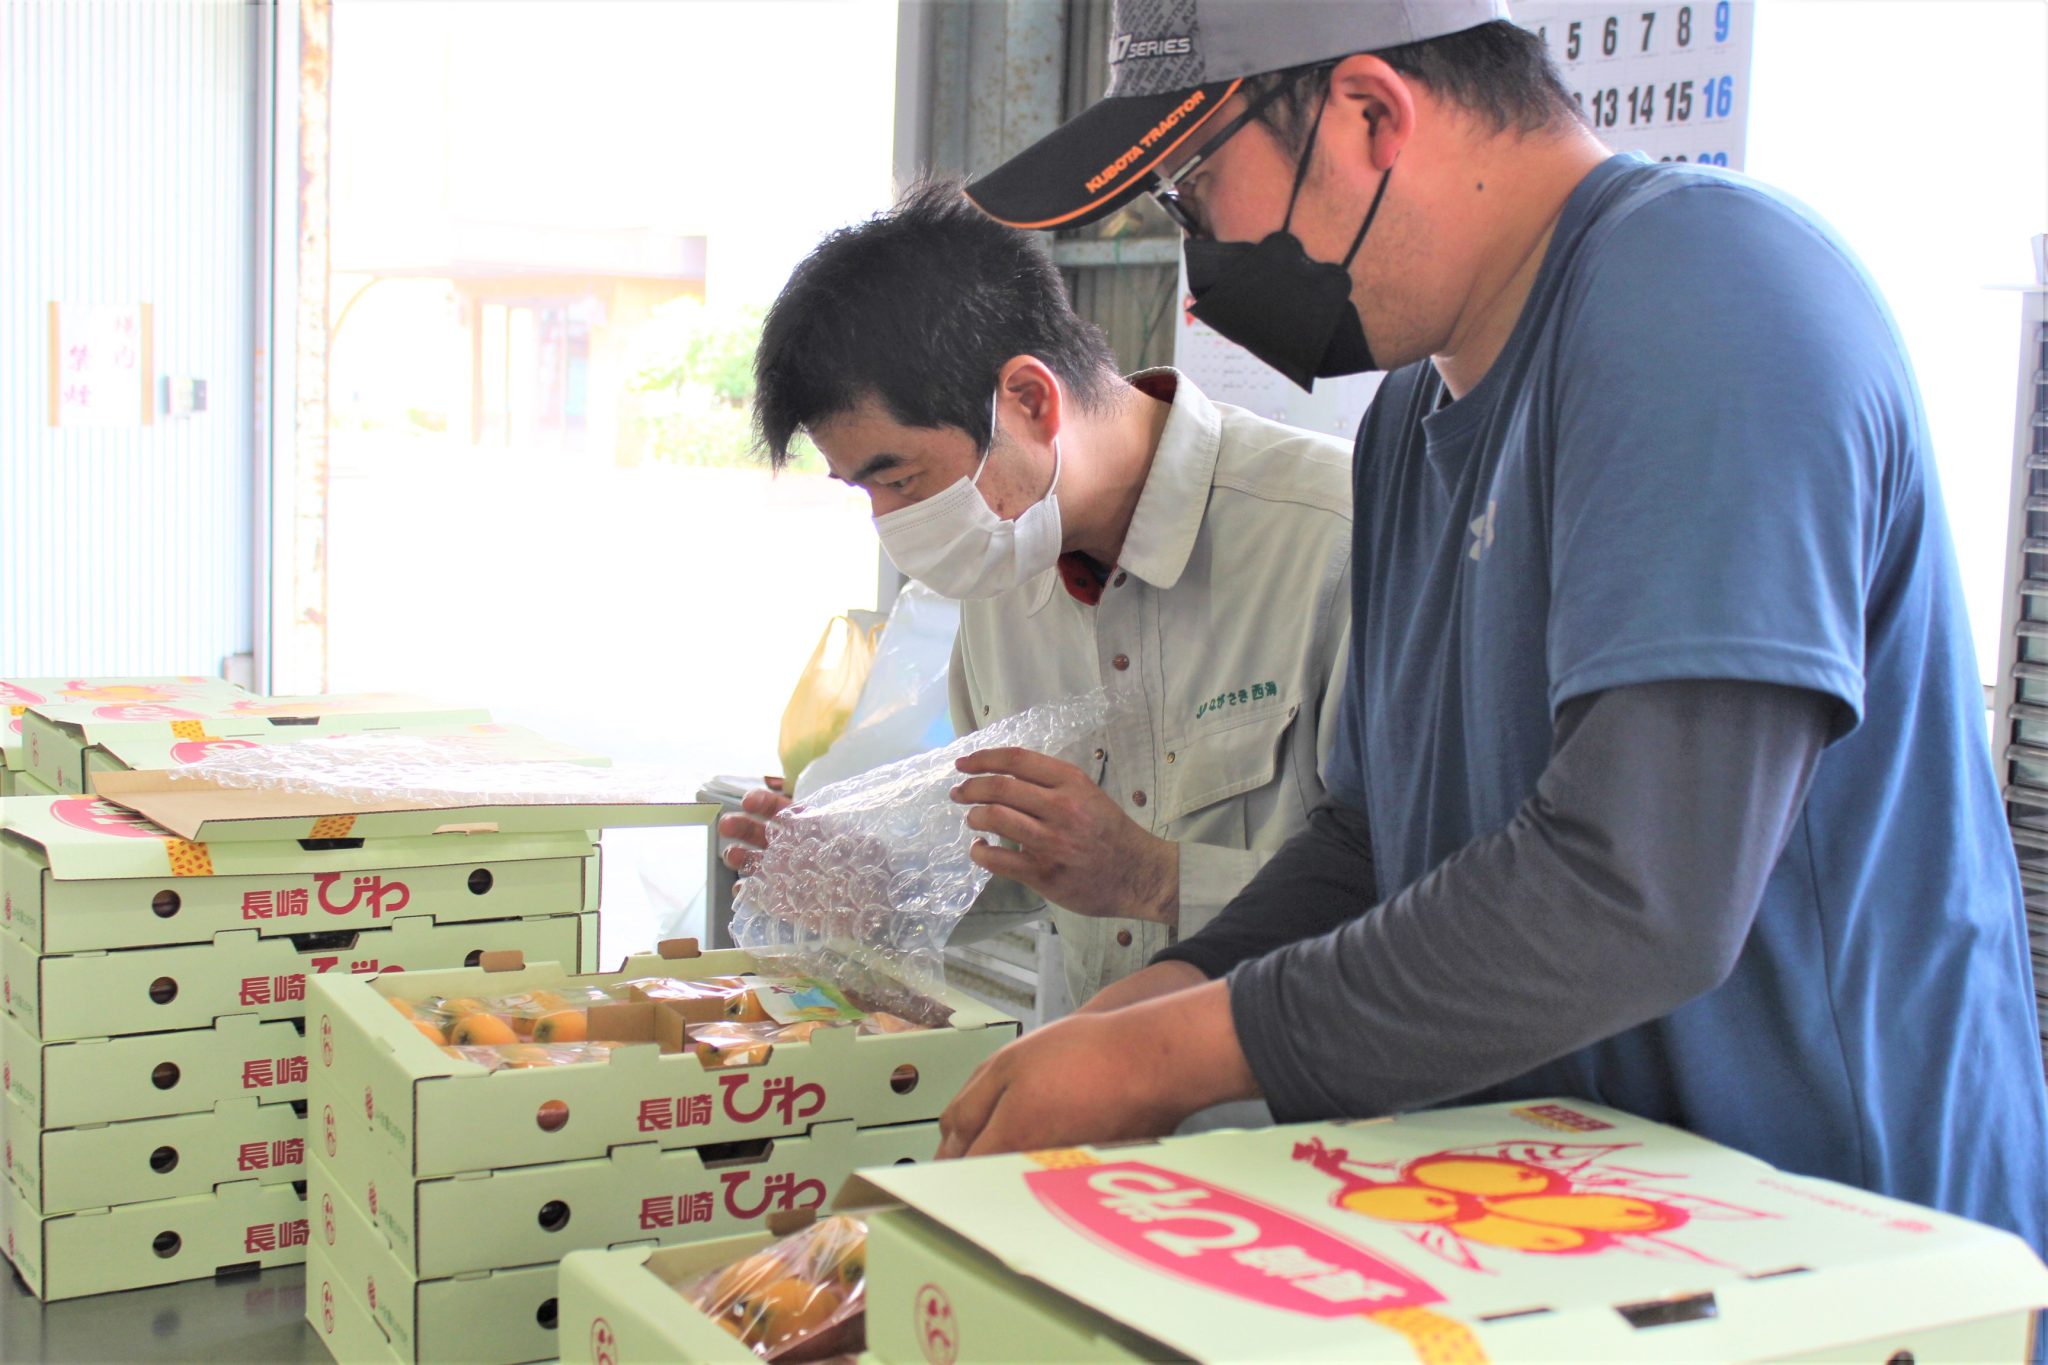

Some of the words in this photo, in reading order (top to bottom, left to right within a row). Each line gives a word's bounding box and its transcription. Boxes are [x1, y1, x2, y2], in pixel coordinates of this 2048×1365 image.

[1127, 37, 1191, 59] SERIES
[1567, 22, 1581, 60] 5
[1603, 16, 1618, 56] 6
[1641, 12, 1655, 51] 7
[1677, 6, 1692, 47] 8
[1715, 1, 1730, 43] 9
[1592, 88, 1618, 127] 13
[1628, 85, 1655, 125] 14
[1664, 80, 1693, 122] 15
[1703, 75, 1732, 119] 16
[1085, 145, 1144, 193] KUBOTA
[1139, 90, 1205, 147] TRACTOR
[241, 872, 410, 920] 長崎びわ
[241, 1055, 309, 1089] 長崎
[636, 1073, 826, 1132] 長崎びわ
[237, 1137, 304, 1171] 長崎
[244, 1218, 310, 1254] 長崎
